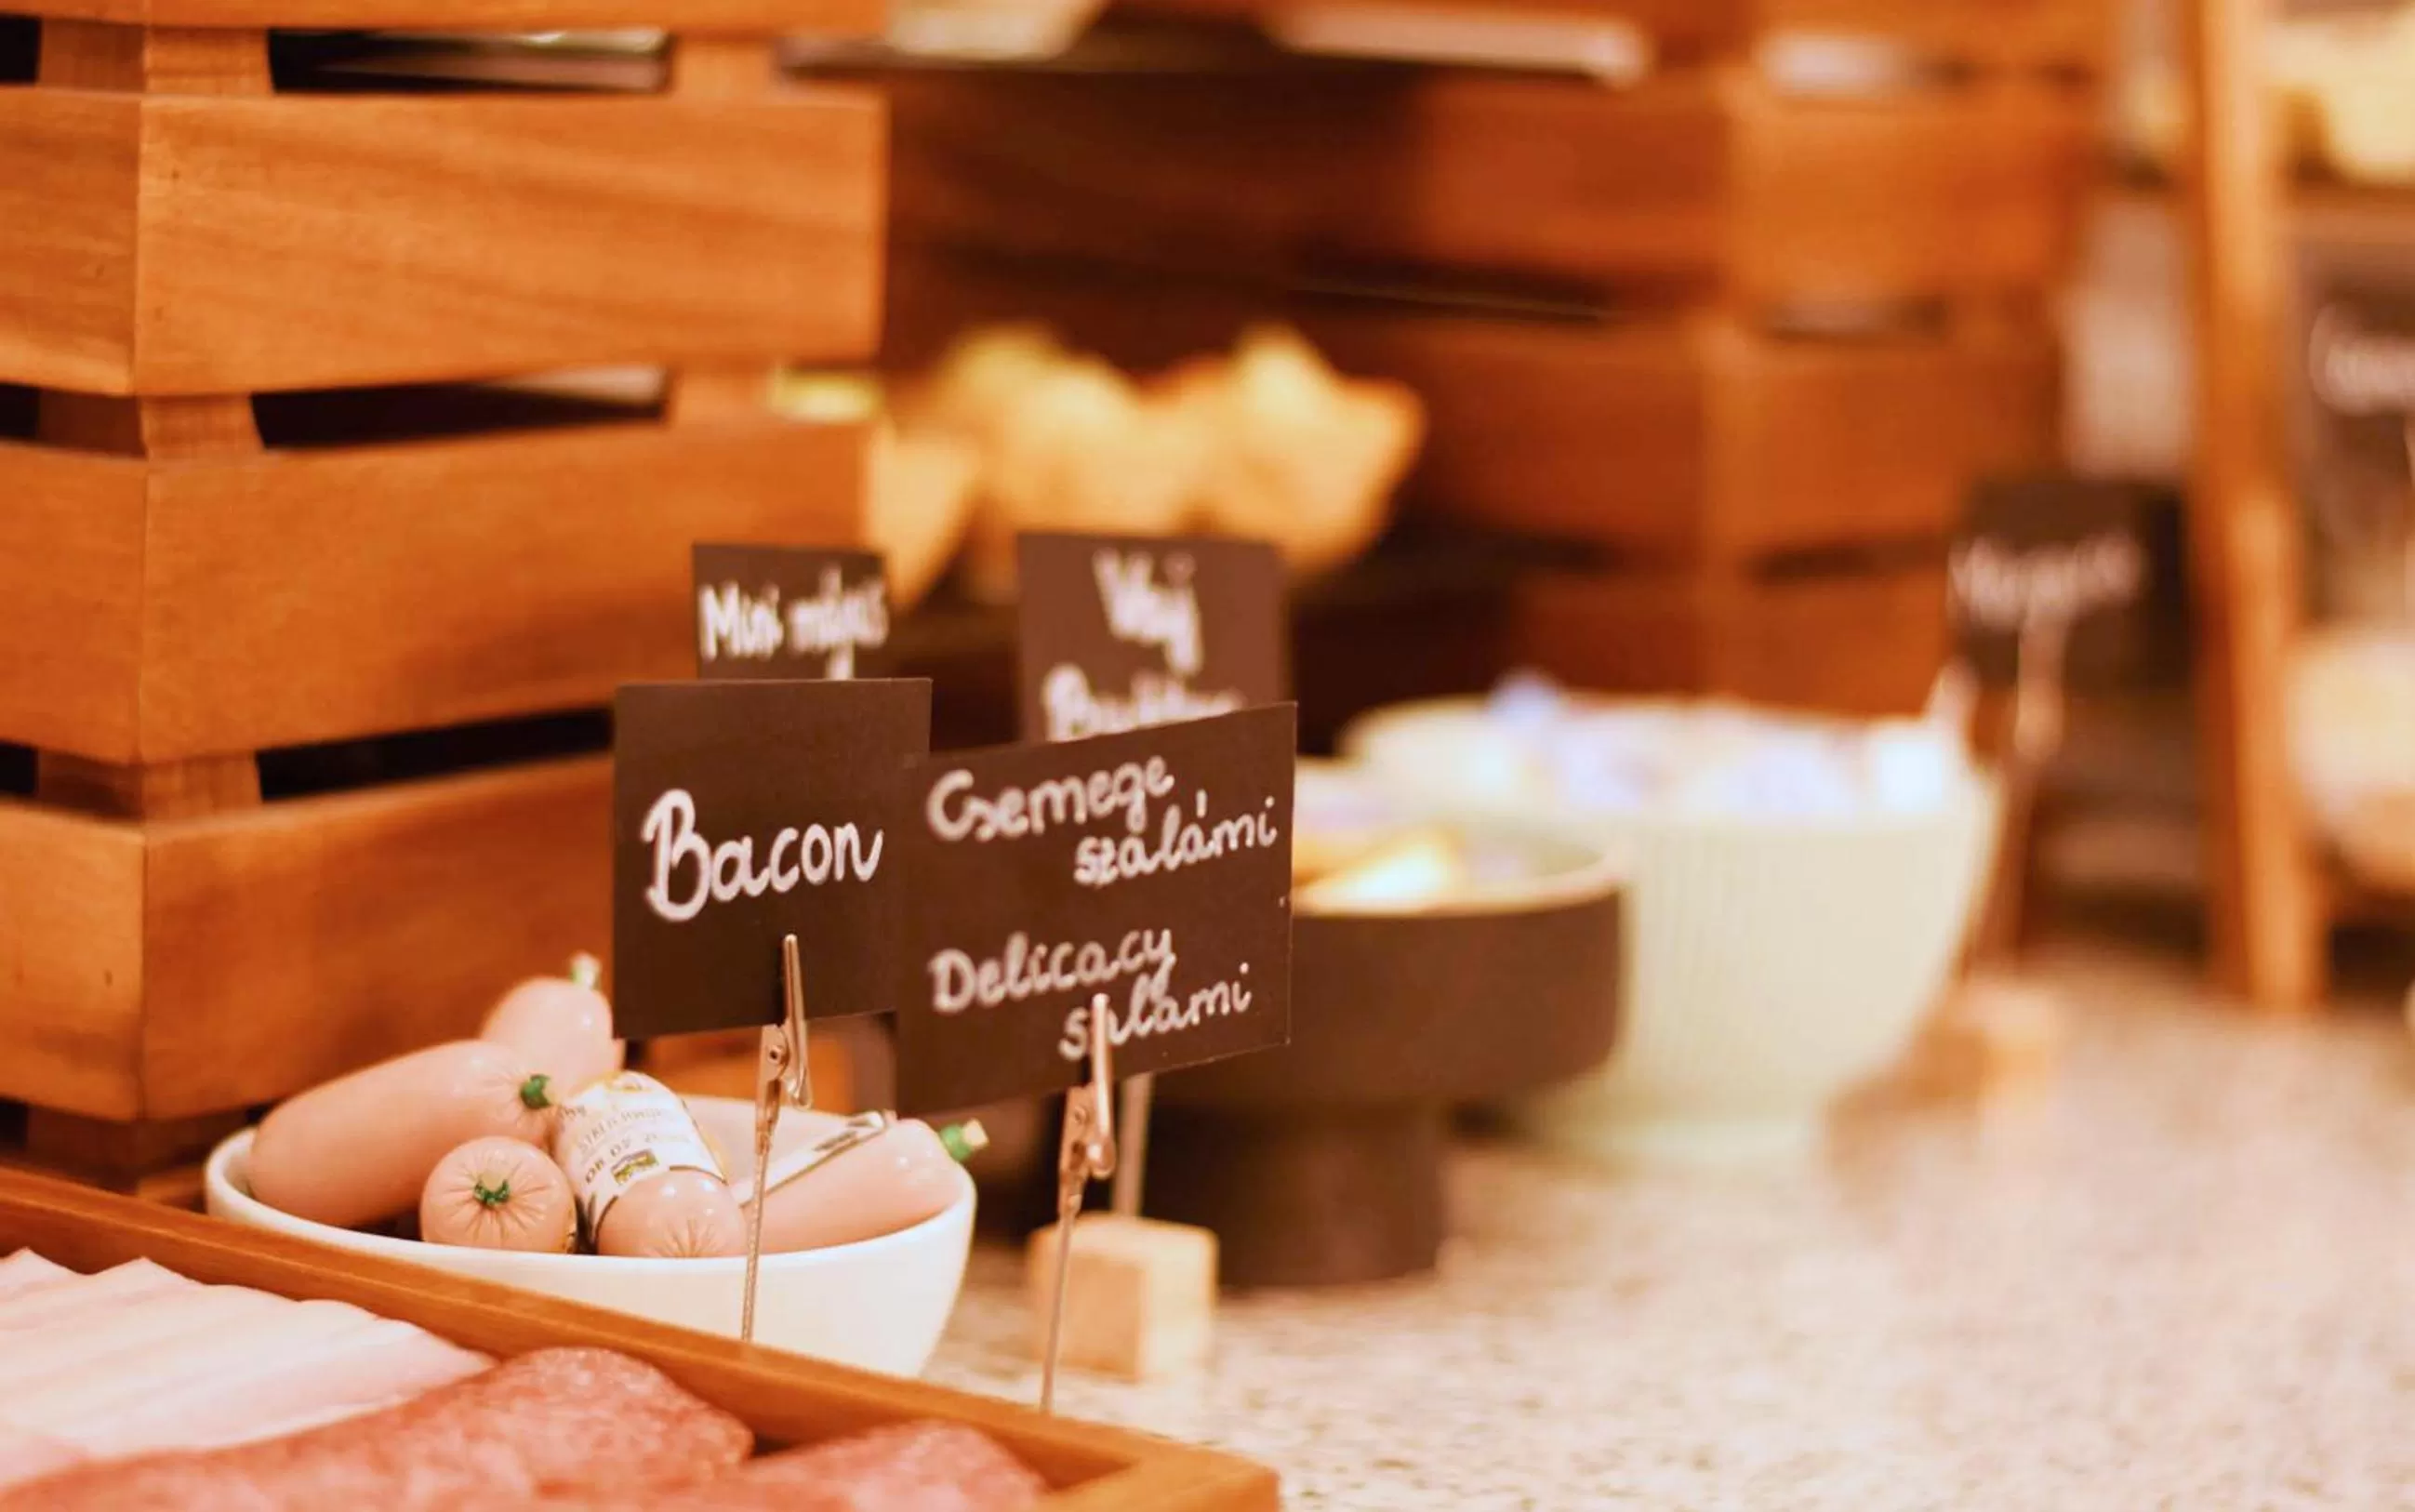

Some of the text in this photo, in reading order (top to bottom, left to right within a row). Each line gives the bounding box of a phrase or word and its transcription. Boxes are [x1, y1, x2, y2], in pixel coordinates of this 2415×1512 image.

[927, 756, 1174, 842] Csemege
[1073, 789, 1278, 888] szalámi
[644, 789, 883, 921] Bacon
[928, 929, 1176, 1014] Delicacy
